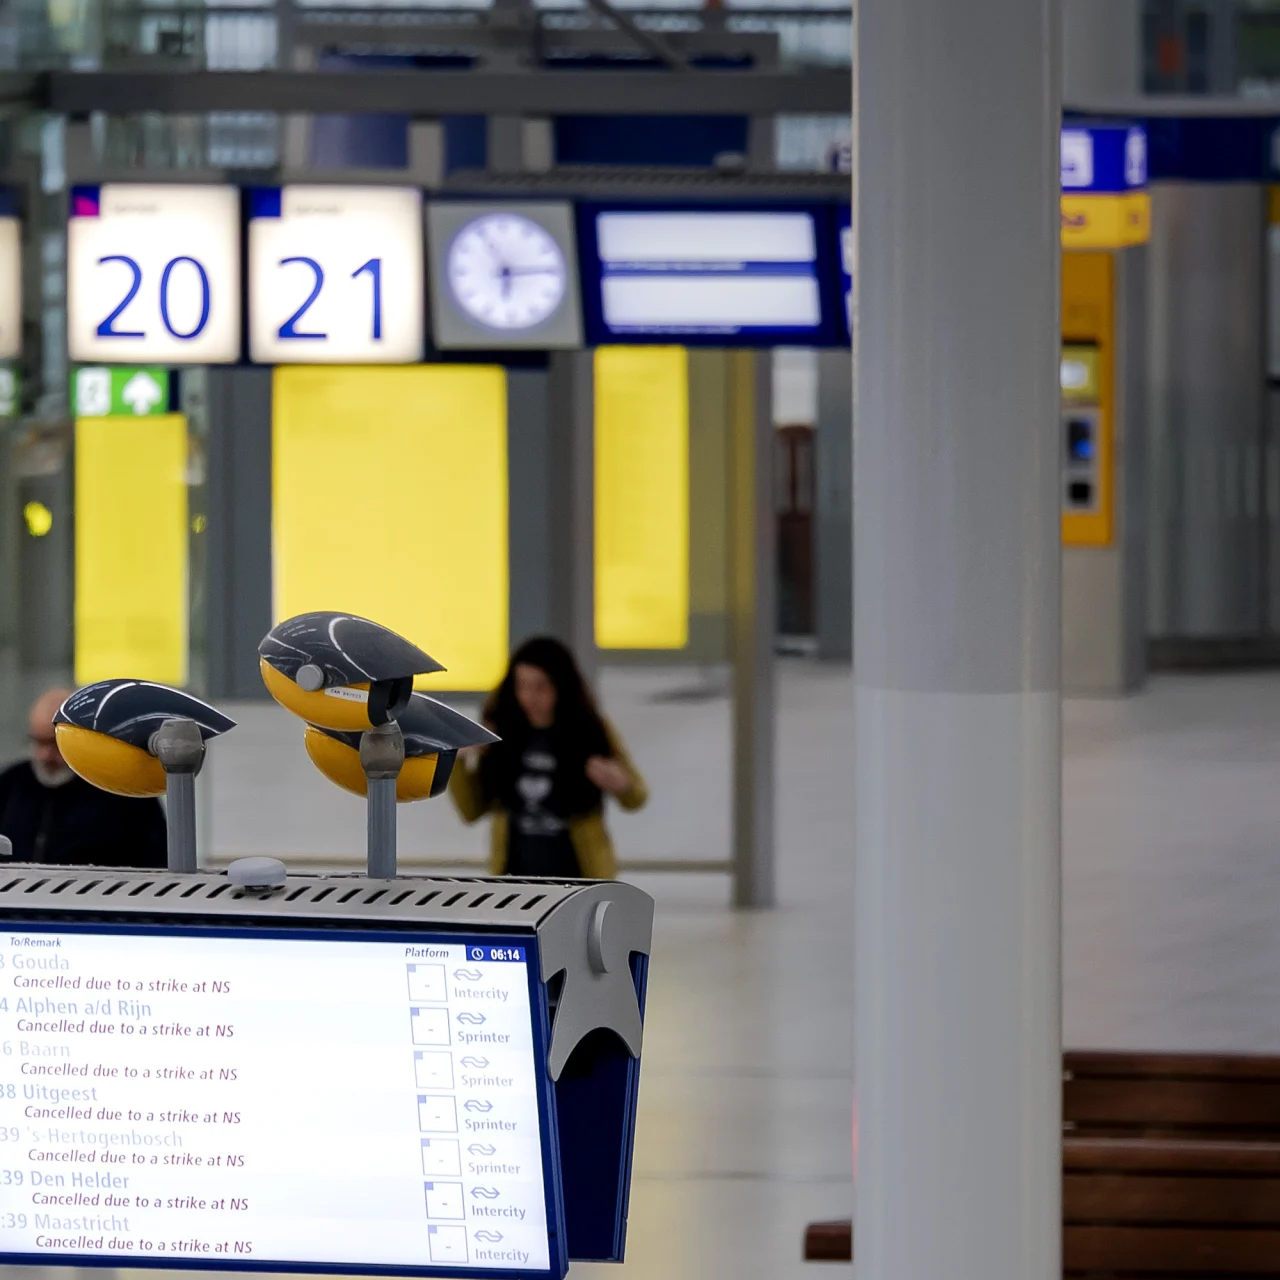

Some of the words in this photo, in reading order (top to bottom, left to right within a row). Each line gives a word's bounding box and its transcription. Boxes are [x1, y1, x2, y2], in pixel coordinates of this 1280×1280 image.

[96, 254, 212, 340] 20
[277, 257, 383, 340] 21
[11, 937, 61, 947] To/Remark
[405, 948, 449, 957] Platform
[491, 950, 519, 960] 06:14
[12, 954, 69, 970] Gouda
[14, 976, 81, 988] Cancelled
[86, 977, 111, 989] due
[117, 979, 130, 990] to
[136, 982, 143, 990] a
[149, 979, 187, 992] strike
[193, 982, 206, 992] at
[212, 981, 230, 993] NS
[455, 988, 508, 1002] Intercity
[16, 997, 77, 1017] Alphen
[85, 999, 111, 1015] a/d
[119, 1000, 151, 1020] Rijn
[458, 1031, 510, 1044] Sprinter
[20, 1041, 69, 1057] Baarn
[462, 1075, 513, 1088] Sprinter
[24, 1084, 97, 1104] Uitgeest
[465, 1119, 517, 1131] Sprinter
[27, 1127, 182, 1149] 's-Hertogenbosch
[469, 1163, 520, 1175] Sprinter
[31, 1171, 64, 1186] Den
[72, 1172, 129, 1188] Helder
[472, 1205, 525, 1220] Intercity
[35, 1214, 130, 1231] Maastricht
[476, 1249, 529, 1264] Intercity
